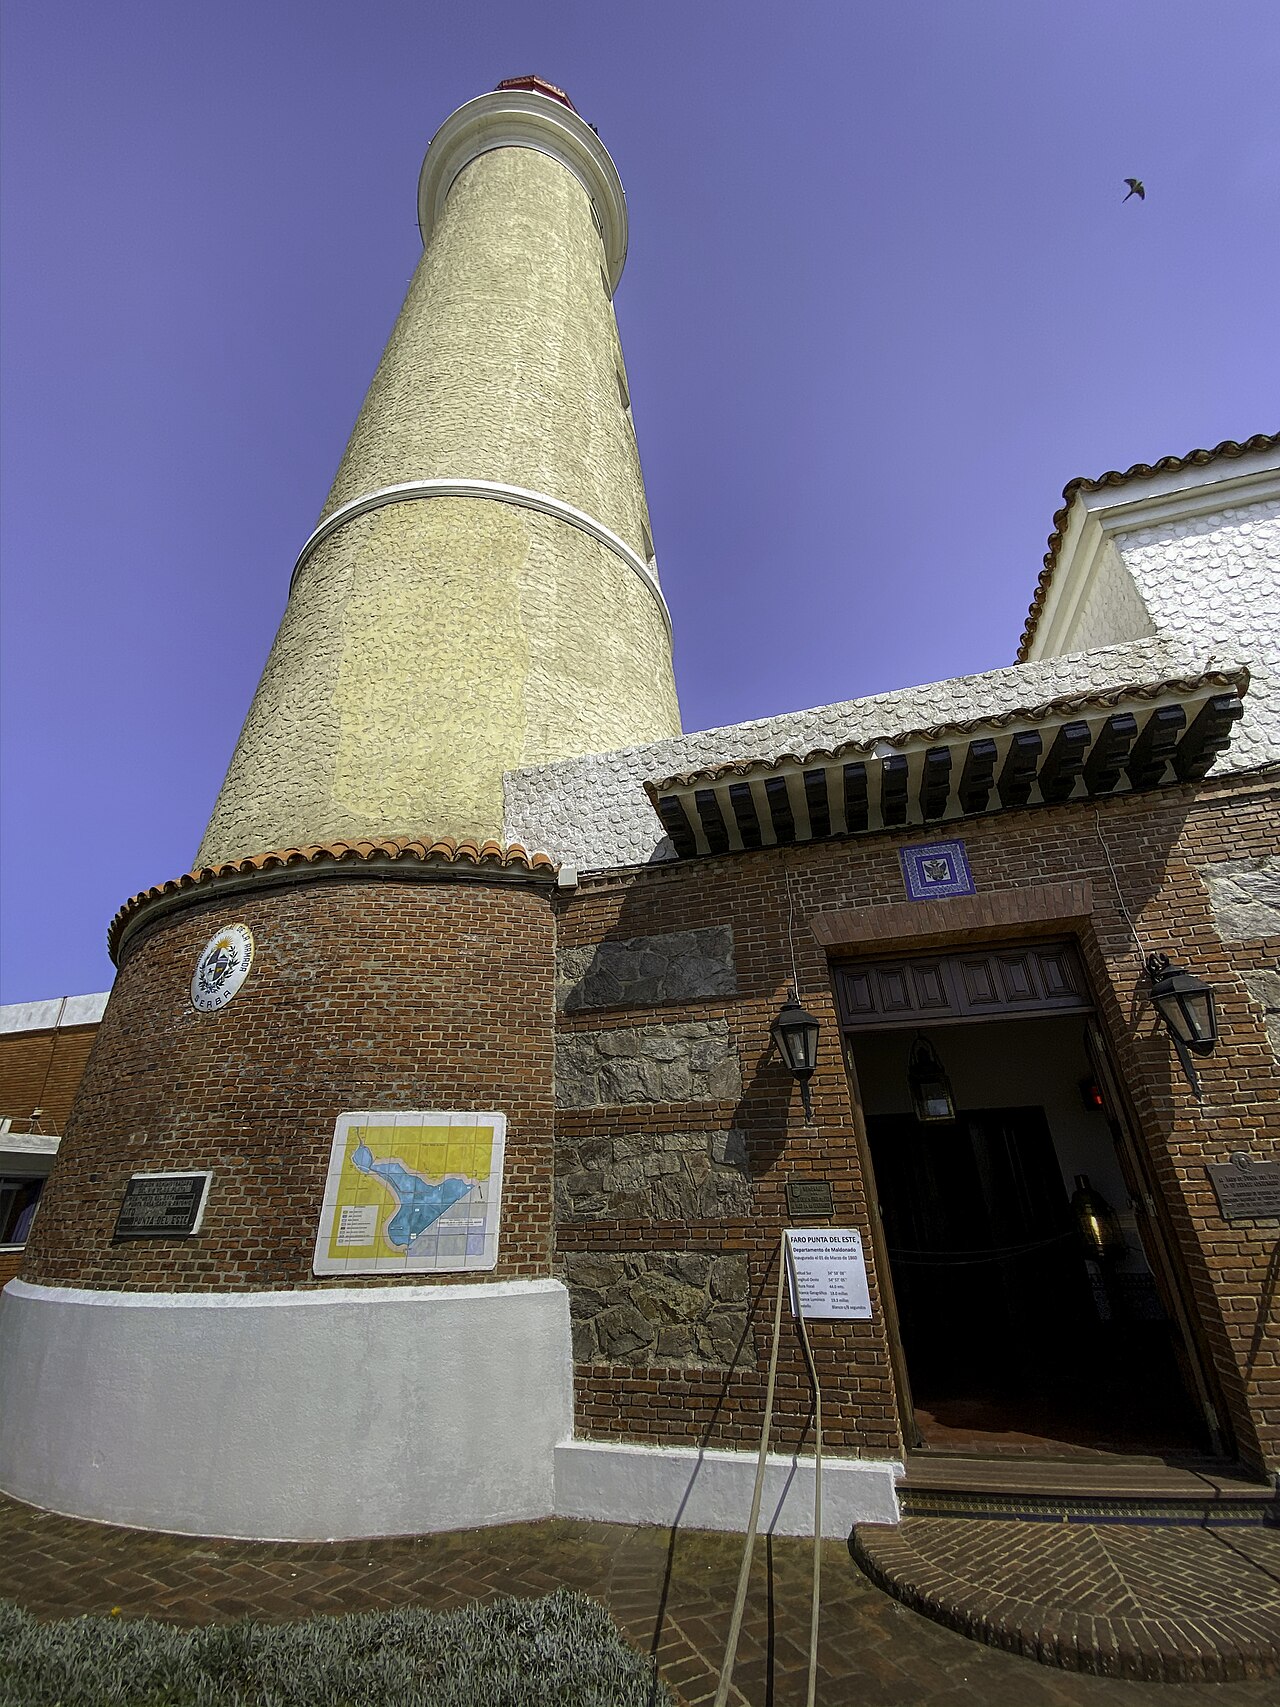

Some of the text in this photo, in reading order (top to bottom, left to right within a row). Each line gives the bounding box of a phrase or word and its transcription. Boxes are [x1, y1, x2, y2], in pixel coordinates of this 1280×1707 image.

[242, 932, 251, 942] LA
[240, 943, 252, 973] ARMADA
[194, 989, 232, 1009] SERBA
[133, 1215, 189, 1225] PUNTA DEL ESTE
